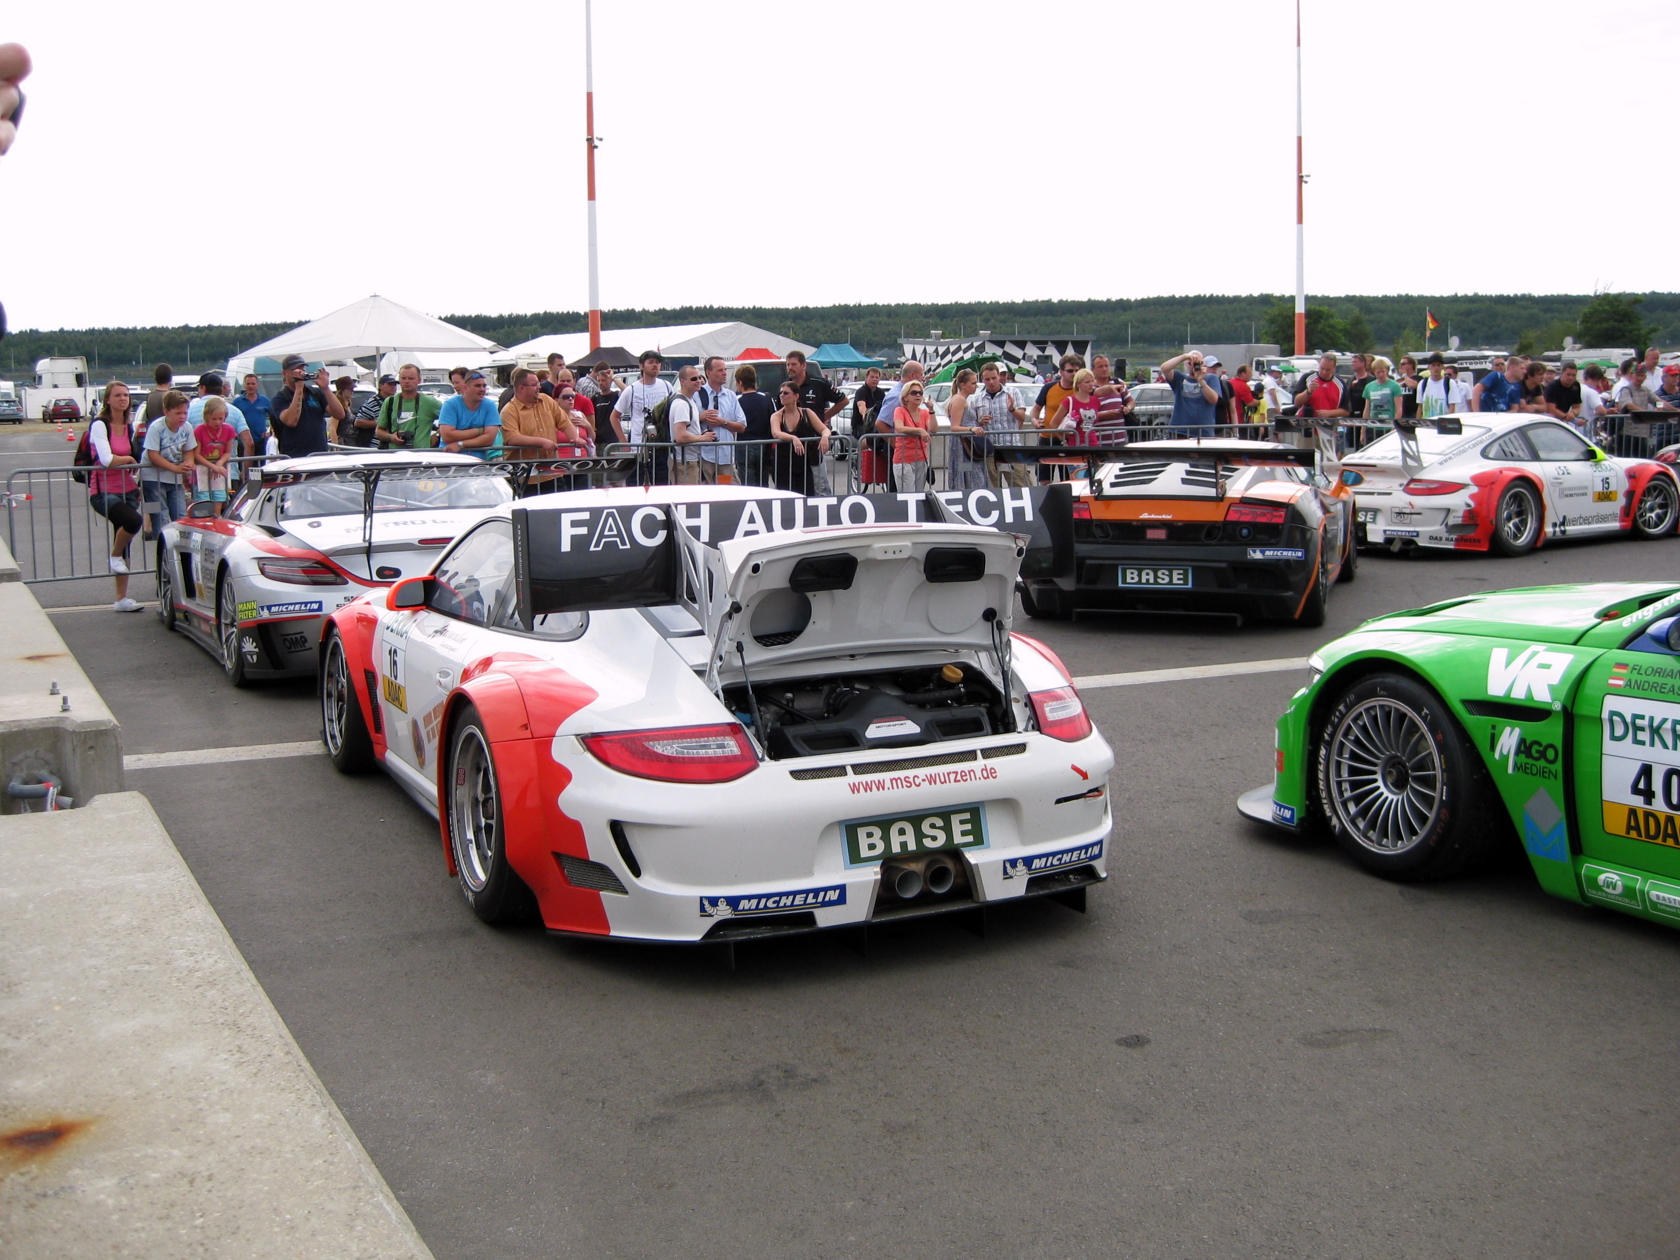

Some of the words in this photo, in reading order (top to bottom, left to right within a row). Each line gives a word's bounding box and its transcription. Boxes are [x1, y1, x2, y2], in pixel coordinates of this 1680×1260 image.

[1590, 464, 1616, 473] DEKRA
[1600, 477, 1610, 491] 15
[1596, 491, 1613, 502] ADAC
[561, 503, 710, 553] FACH
[733, 495, 876, 540] AUTO
[897, 486, 1035, 527] TECH
[1126, 568, 1184, 584] BASE
[238, 600, 257, 611] MANN
[238, 610, 257, 620] FILTER
[270, 602, 320, 613] MICHELIN
[283, 635, 309, 650] OMP
[388, 645, 398, 681] 16
[1487, 645, 1575, 702] VR
[387, 681, 403, 708] ADAC
[848, 763, 998, 794] www.msc-wurzen.de
[1317, 744, 1332, 817] MICHELIN
[1513, 760, 1558, 781] MEDIEN
[1629, 762, 1680, 812] 40
[856, 812, 974, 858] BASE
[1031, 843, 1101, 870] MICHELIN
[737, 888, 841, 911] MICHELIN
